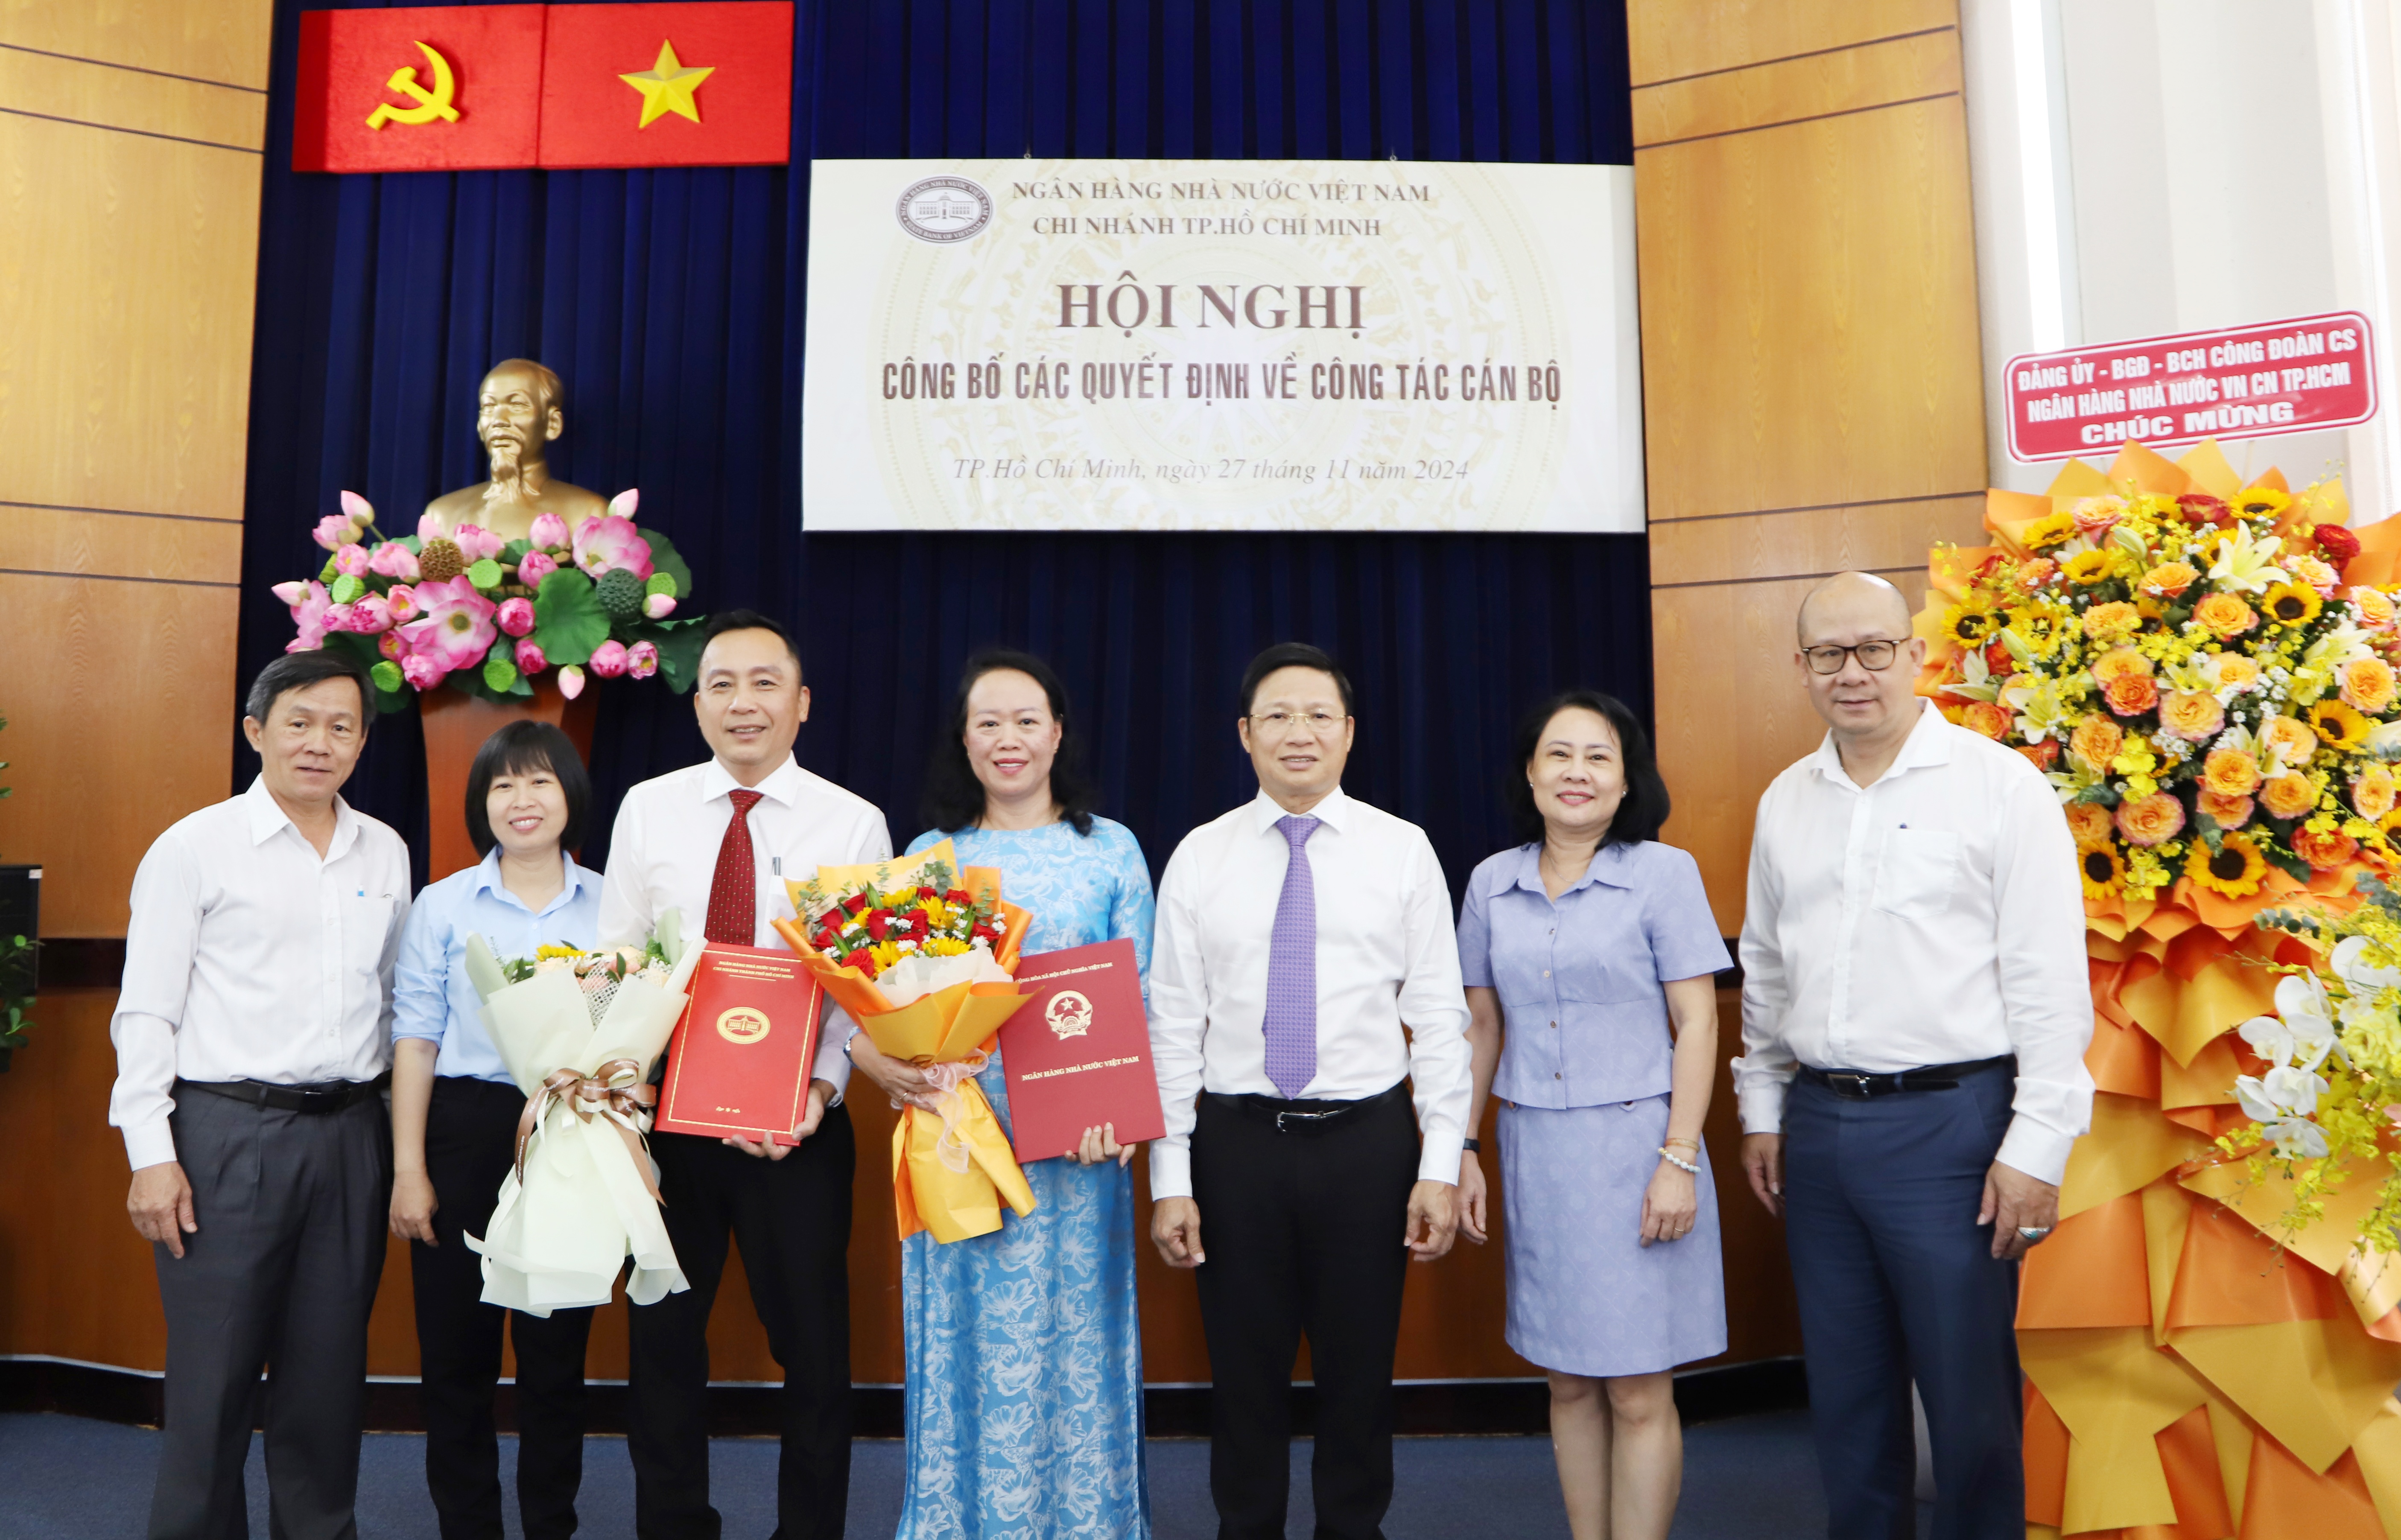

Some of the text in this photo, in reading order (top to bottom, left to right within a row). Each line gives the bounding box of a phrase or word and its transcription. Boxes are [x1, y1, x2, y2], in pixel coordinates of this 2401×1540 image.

[1012, 177, 1430, 204] NGÂN HÀNG NHÀ NƯỚC VIỆT NAM
[1033, 209, 1382, 236] CHI NHÁNH TP.HỒ CHÍ MINH
[1056, 270, 1367, 339] HỘI NGHỊ
[883, 351, 1561, 410] CÔNG BỐ CÁC QUYẾT ĐỊNH VỀ CÔNG TÁC CÁN BỘ
[2018, 362, 2068, 391] ĐẢNG
[2071, 357, 2095, 385] ỦY
[2111, 355, 2150, 380] BGĐ
[2166, 347, 2207, 374] BCH
[2210, 340, 2265, 368] CÔNG
[2268, 330, 2325, 361] ĐOÀN
[2328, 328, 2358, 353] CS
[2027, 361, 2351, 423] NGÂN HÀNG NHÀ NƯỚC VN CN TP.HCM
[2081, 401, 2295, 445] CHÚC MỪNG
[953, 455, 1469, 484] TP.Hồ Chí Minh, ngày 27 tháng 11 năm 2024
[1022, 1056, 1140, 1081] NGÂN HÀNG NHÀ NƯỚC VIỆT NAM
